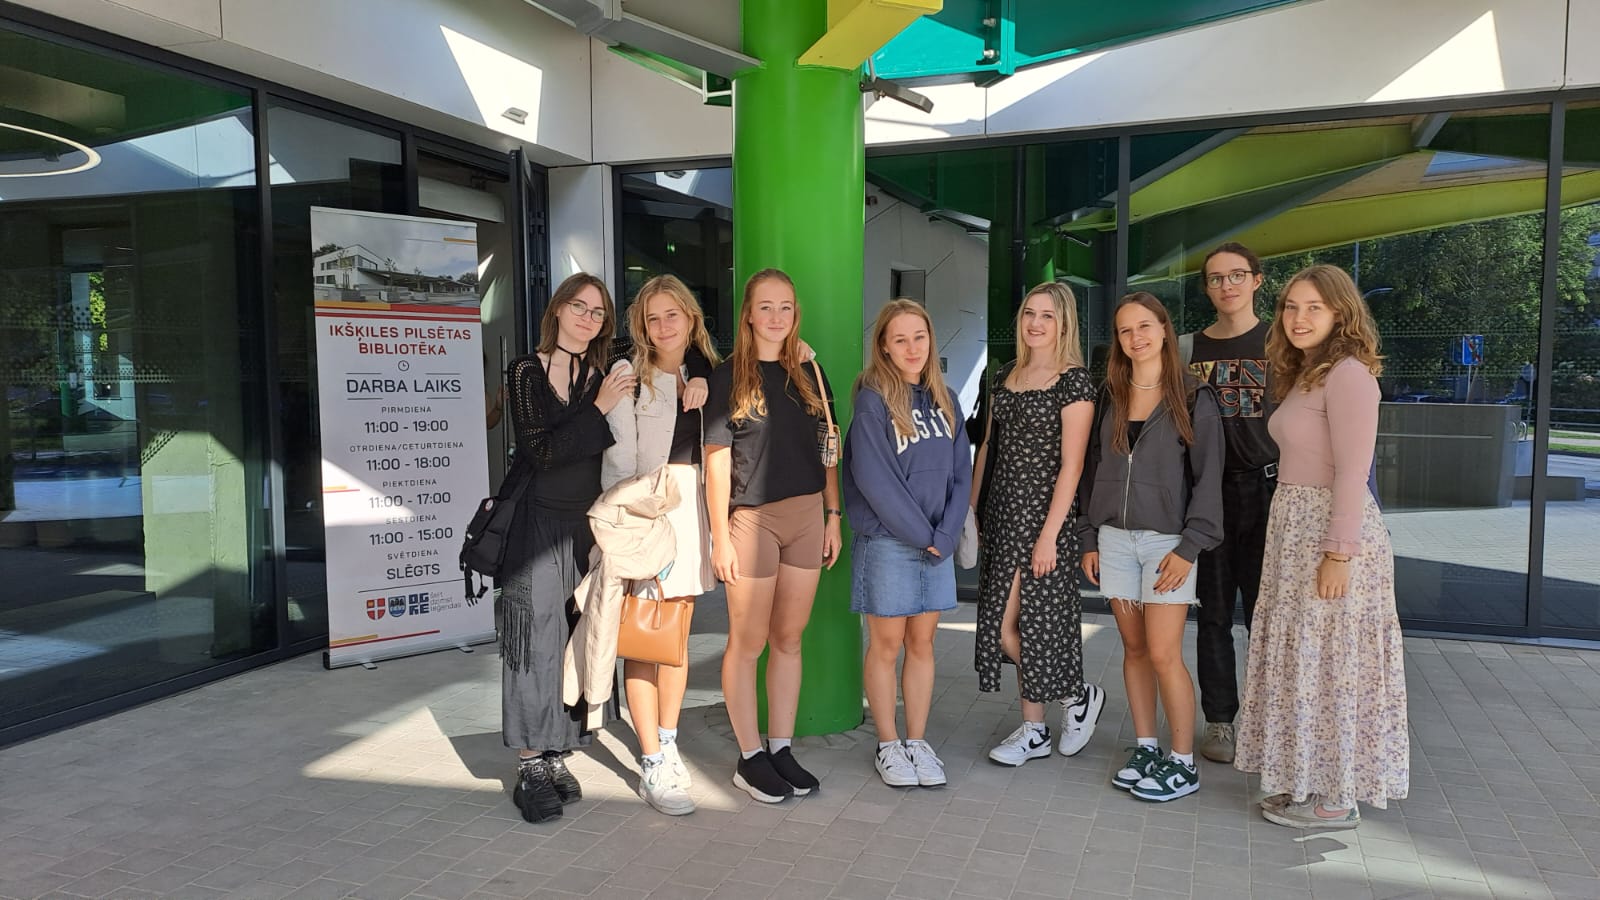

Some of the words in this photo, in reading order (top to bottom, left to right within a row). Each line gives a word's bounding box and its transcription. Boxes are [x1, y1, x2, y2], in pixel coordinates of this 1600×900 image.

[329, 322, 399, 341] IKŠĶILES
[404, 326, 471, 340] PILSĒTAS
[358, 342, 447, 355] BIBLIOTĒKA
[346, 379, 408, 393] DARBA
[413, 379, 462, 393] LAIKS
[381, 406, 432, 414] PIRMDIENA
[364, 421, 399, 434] 11:00
[412, 420, 449, 432] 19:00
[891, 407, 953, 455] BOSTO
[366, 458, 401, 471] 11:00
[414, 456, 451, 469] 18:00
[382, 479, 437, 488] PIEKTDIENA
[368, 495, 403, 509] 11:00
[416, 491, 451, 505] 17:00
[369, 531, 404, 545] 11:00
[417, 527, 453, 541] 15:00
[386, 563, 441, 580] SLĒGTS
